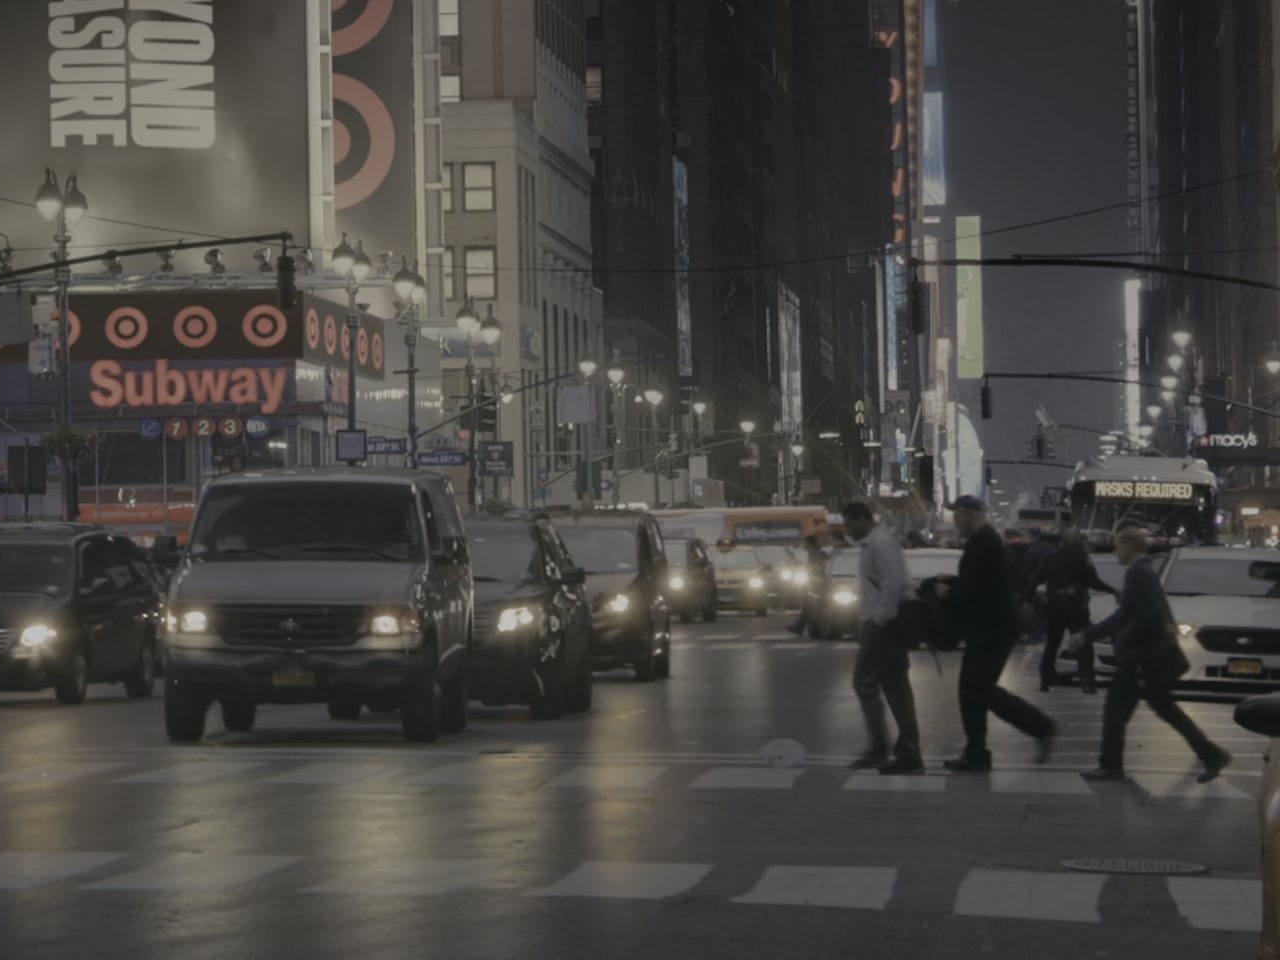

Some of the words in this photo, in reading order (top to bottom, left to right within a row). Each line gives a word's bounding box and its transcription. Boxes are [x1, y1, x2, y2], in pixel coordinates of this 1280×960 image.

[89, 358, 287, 414] Subway
[171, 421, 182, 436] 1
[198, 420, 210, 436] 2
[224, 420, 237, 436] 3
[1095, 481, 1134, 497] MASKS
[1135, 482, 1193, 499] REQUIRED
